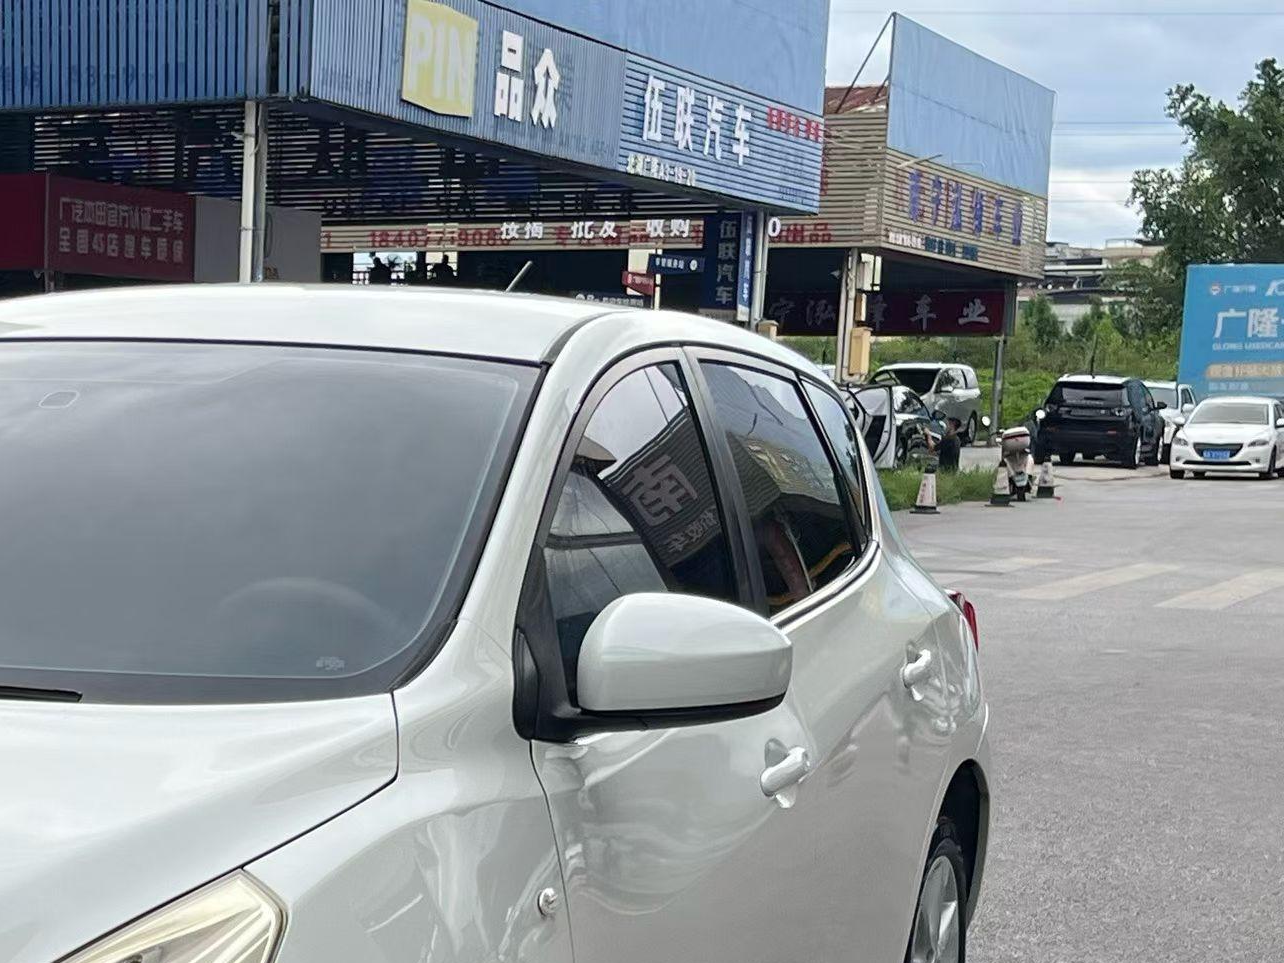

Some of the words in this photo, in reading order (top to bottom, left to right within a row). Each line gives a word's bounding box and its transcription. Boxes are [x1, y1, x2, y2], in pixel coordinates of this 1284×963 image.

[408, 12, 478, 106] PIN
[494, 30, 560, 128] 品众
[642, 74, 752, 167] 伍联汽车
[1214, 308, 1280, 338] 广隆
